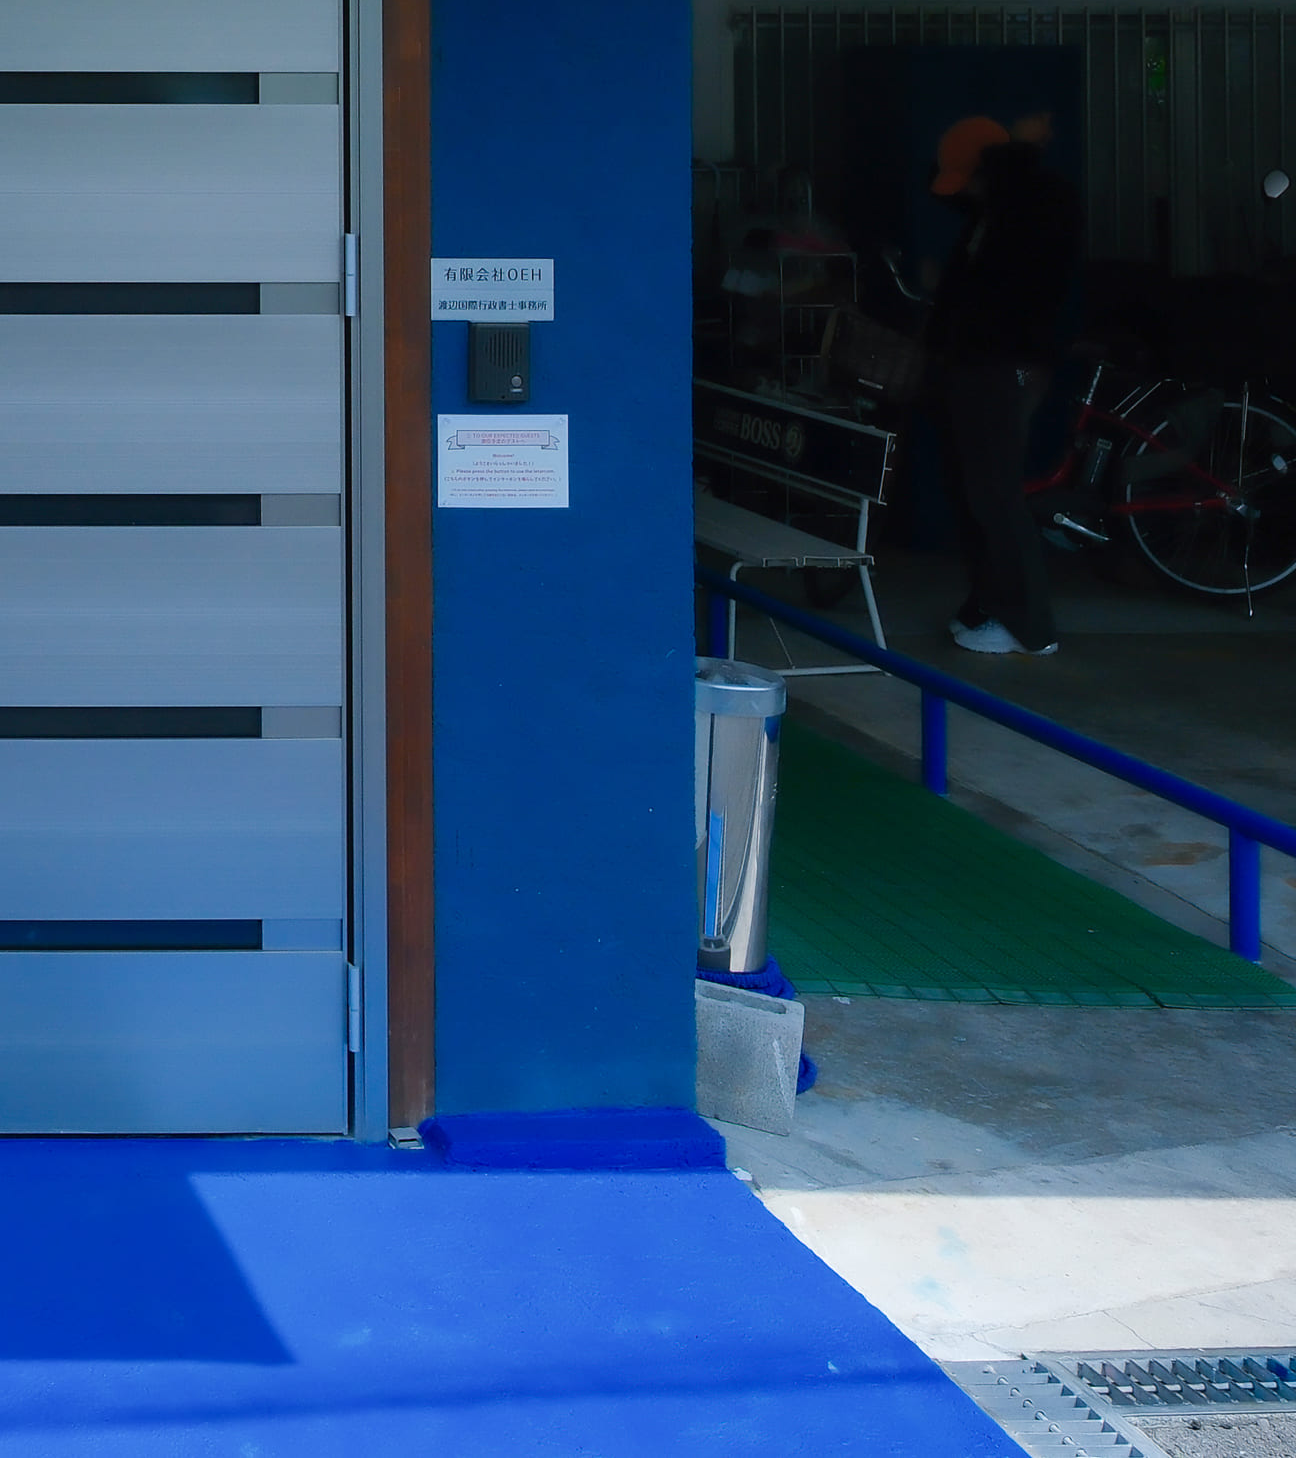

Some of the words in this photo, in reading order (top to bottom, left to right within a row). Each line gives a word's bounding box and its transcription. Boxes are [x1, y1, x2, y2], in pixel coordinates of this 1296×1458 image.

[444, 267, 542, 282] 有限会社OEH
[740, 413, 782, 450] BOSS
